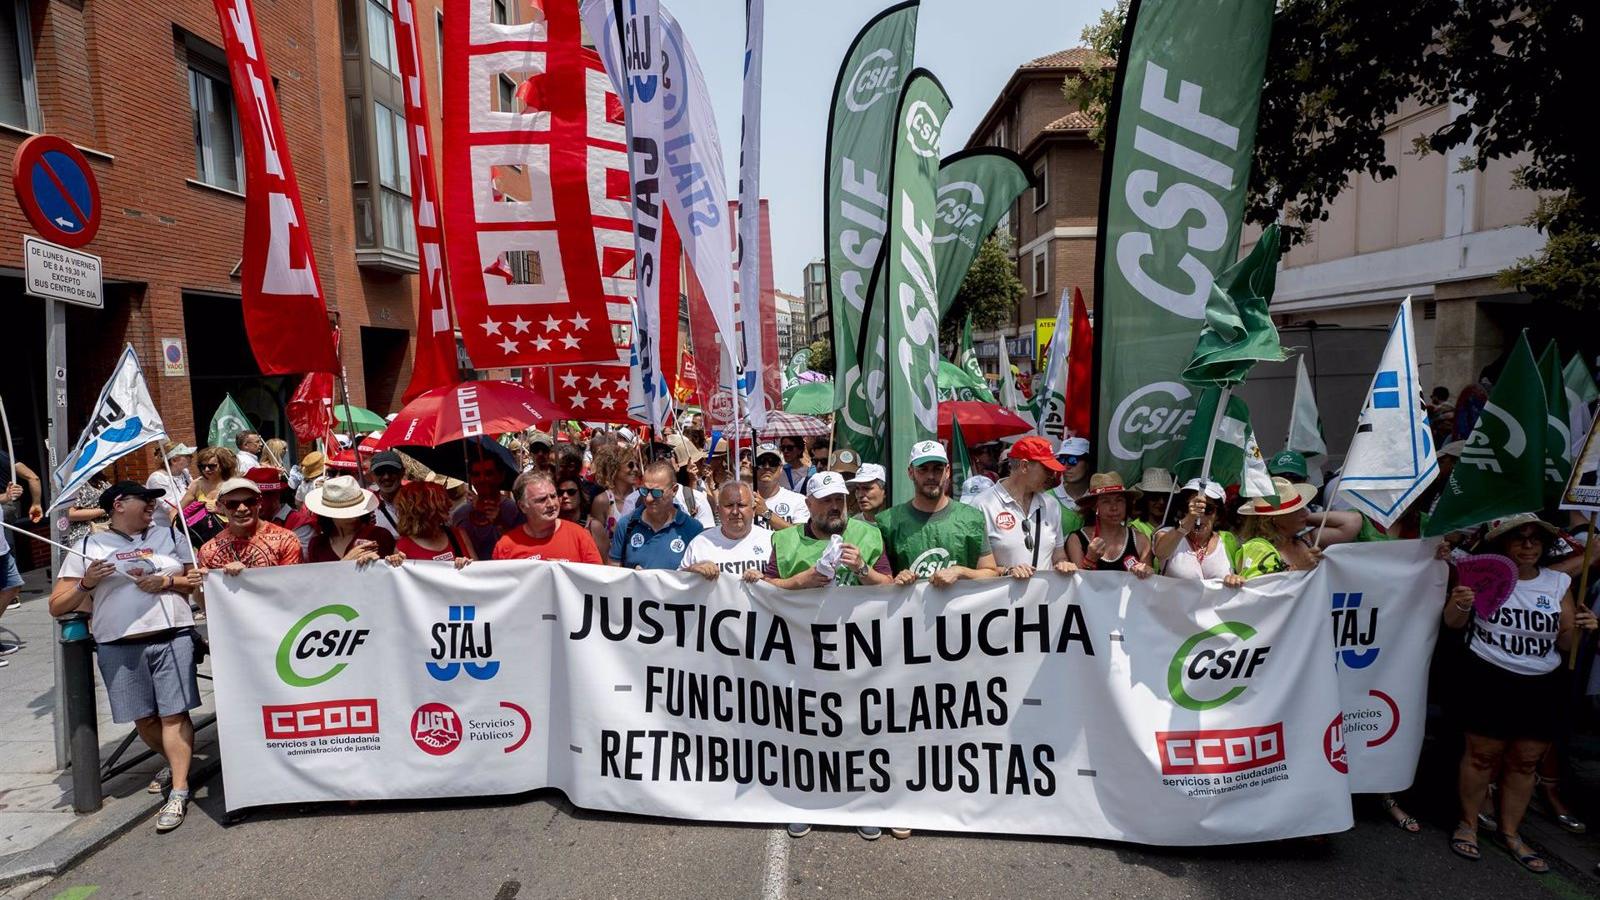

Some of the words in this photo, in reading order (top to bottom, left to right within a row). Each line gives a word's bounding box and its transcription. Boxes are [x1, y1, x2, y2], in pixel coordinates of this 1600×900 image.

[856, 65, 899, 93] CSIF
[1116, 60, 1240, 319] CSIF
[935, 197, 983, 229] CSIF
[31, 247, 41, 256] DE
[42, 250, 63, 262] LUNES
[71, 258, 96, 271] VIERNES
[43, 260, 52, 269] DE
[34, 279, 49, 289] BUS
[50, 282, 76, 295] CENTRO
[77, 289, 86, 297] DE
[86, 290, 97, 299] DÍA
[51, 273, 80, 286] EXCEPTO
[457, 386, 483, 437] CCOO
[1124, 406, 1196, 434] CSIF
[430, 622, 492, 660] STAJ
[569, 593, 796, 665] JUSTICIA
[810, 618, 883, 671] EN
[902, 604, 1096, 665] LUCHA
[1331, 607, 1379, 648] TAJ
[296, 629, 371, 660] CSIF
[1187, 646, 1272, 680] CSIF
[645, 665, 843, 738] FUNCIONES
[859, 676, 1009, 736] CLARAS
[1343, 709, 1382, 721] ervicios
[271, 705, 373, 733] CCOO
[418, 711, 454, 732] UGT
[469, 719, 515, 729] Servicios
[1343, 721, 1379, 733] úblicos
[266, 741, 308, 749] servicios
[319, 738, 328, 746] la
[330, 735, 380, 745] ciudadanía
[470, 731, 514, 741] Públicos
[1166, 731, 1278, 766] CCOO
[287, 746, 343, 756] administración
[355, 745, 381, 753] justicia
[601, 729, 891, 793] RETRIBUCIONES
[905, 742, 1056, 797] JUSTAS
[1162, 777, 1211, 787] servicios
[1213, 778, 1221, 786] a
[1222, 775, 1233, 784] la
[1235, 763, 1288, 782] ciudadanía
[1188, 782, 1248, 797] administración
[1249, 779, 1260, 787] de
[1261, 774, 1289, 787] justicia
